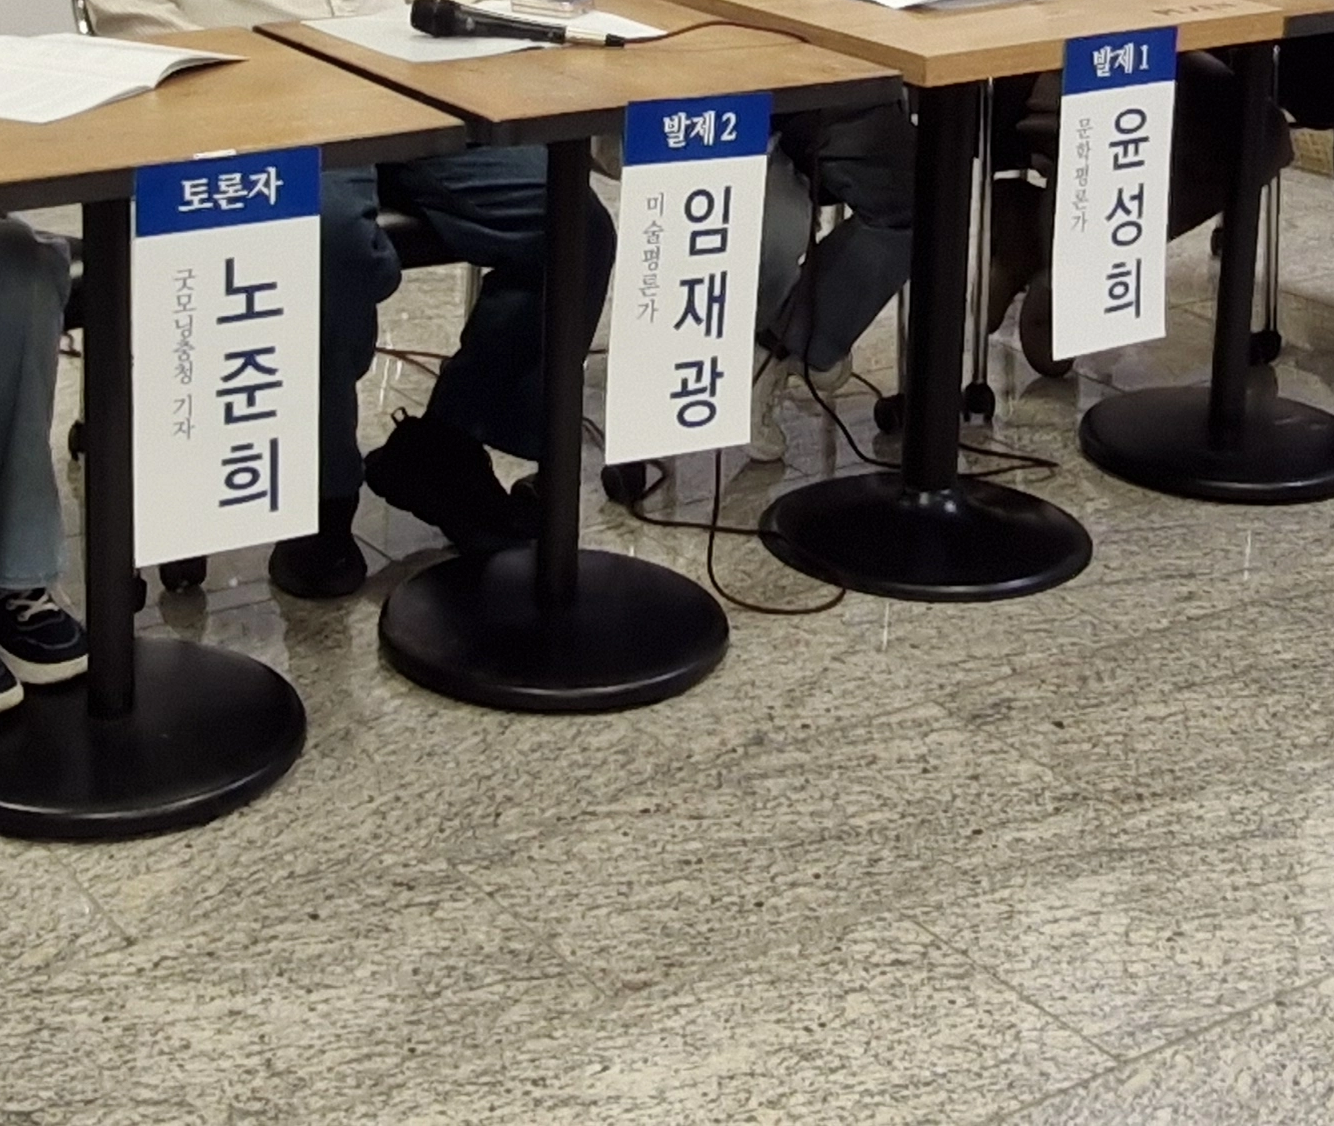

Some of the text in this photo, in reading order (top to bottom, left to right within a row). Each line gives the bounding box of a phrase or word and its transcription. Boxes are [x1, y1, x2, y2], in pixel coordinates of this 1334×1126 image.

[1092, 43, 1150, 77] 발제 1
[178, 167, 283, 213] 토론자
[662, 111, 738, 149] 발제 2
[1104, 107, 1151, 319] 윤성희
[670, 184, 732, 429] 임재광
[215, 257, 285, 513] 노준희
